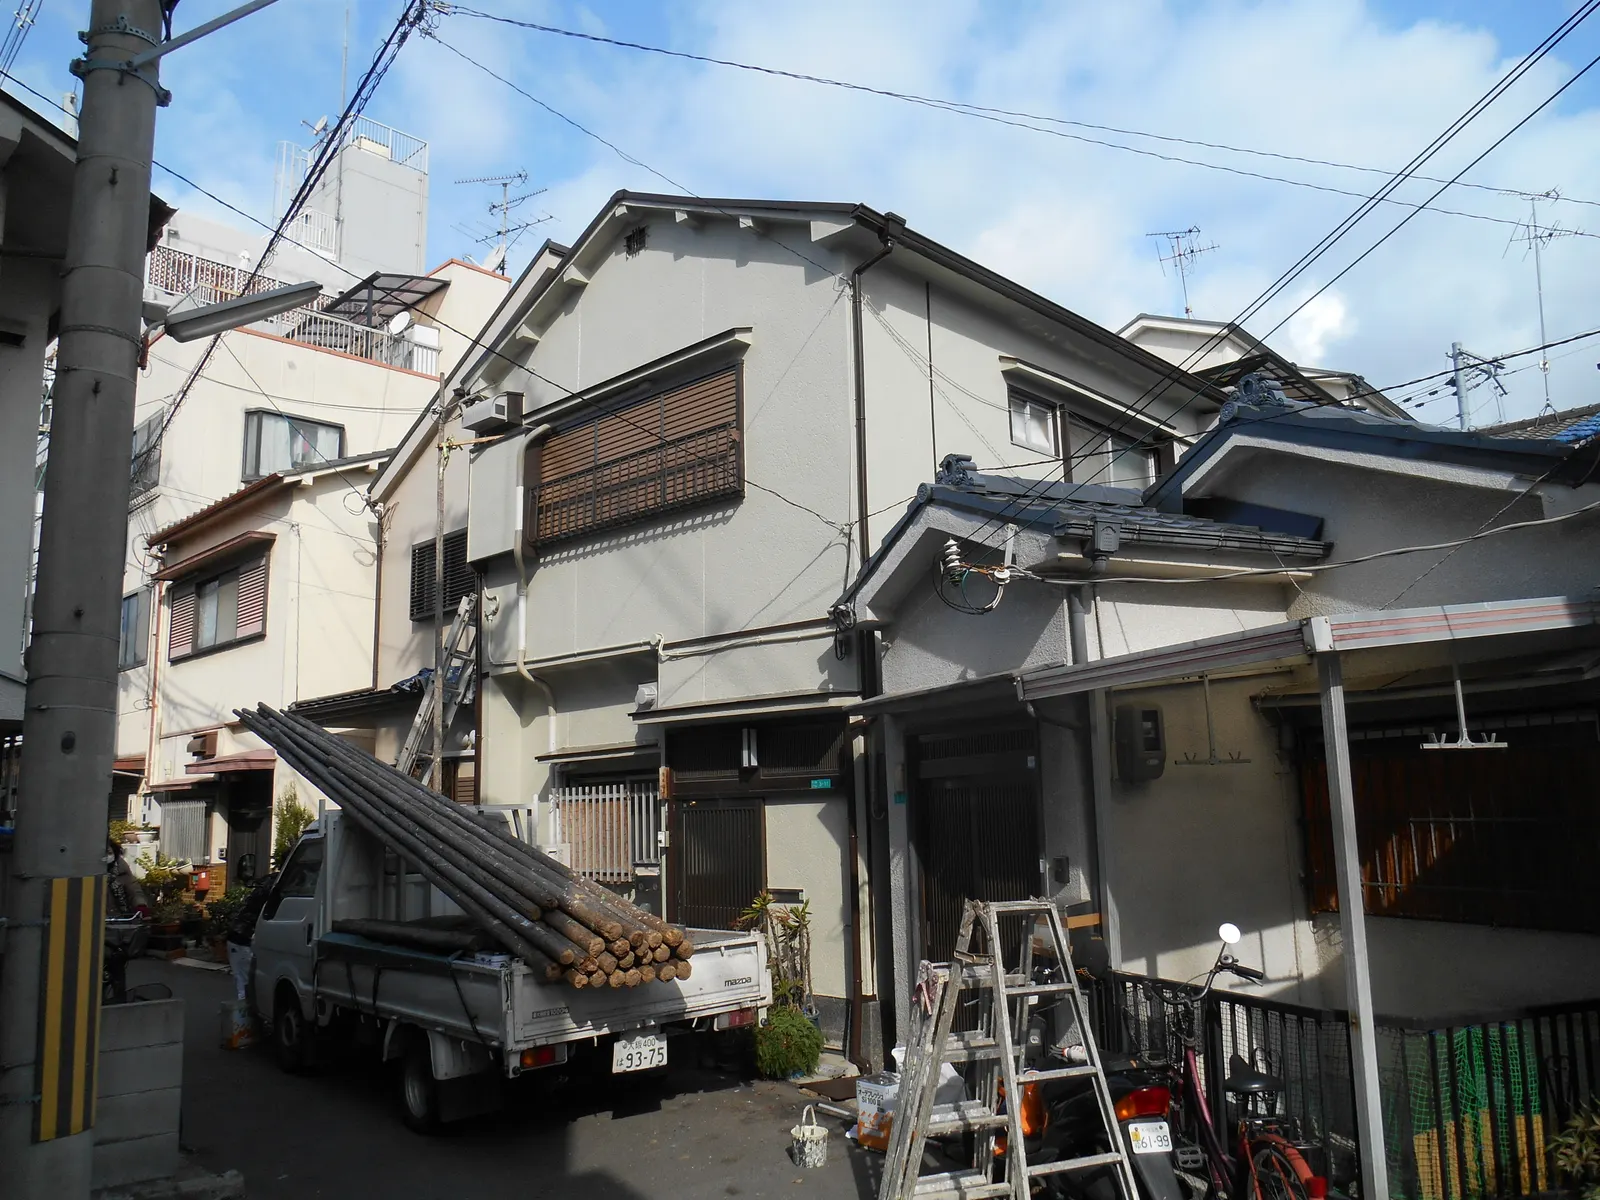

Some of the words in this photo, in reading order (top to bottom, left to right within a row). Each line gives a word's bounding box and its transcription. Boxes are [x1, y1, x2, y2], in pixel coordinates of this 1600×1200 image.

[724, 977, 752, 987] mazda
[626, 1047, 664, 1068] 93-75
[1141, 1135, 1170, 1149] 61-99
